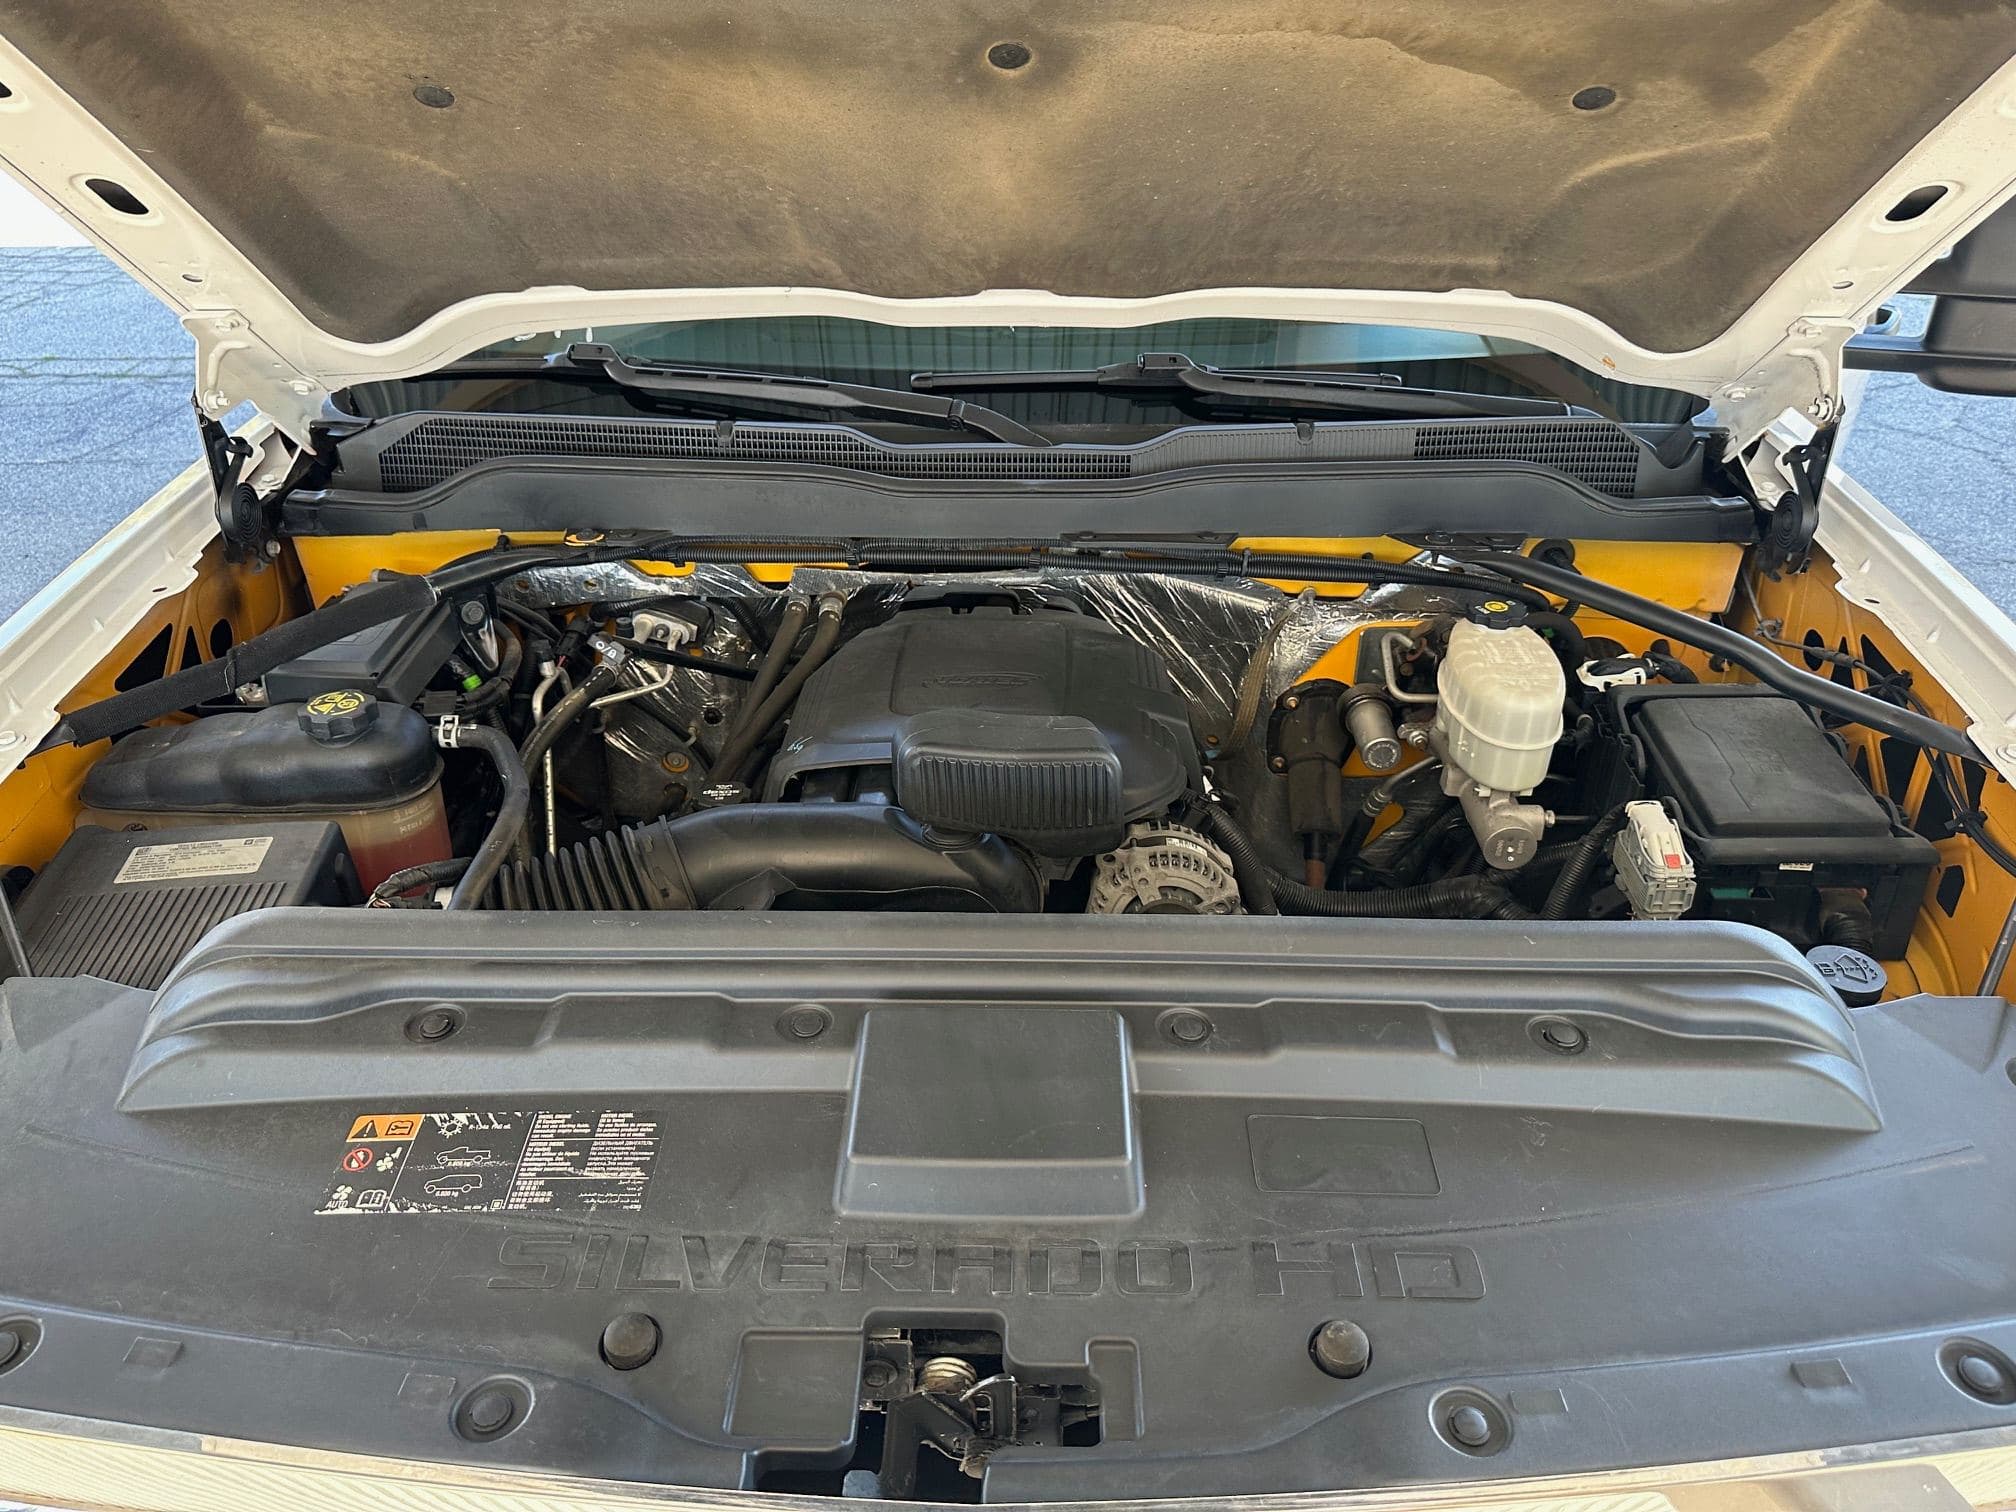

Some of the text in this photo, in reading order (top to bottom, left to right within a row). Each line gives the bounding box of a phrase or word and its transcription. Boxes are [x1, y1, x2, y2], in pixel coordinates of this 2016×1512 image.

[325, 1199, 349, 1209] AUTO
[487, 1233, 1487, 1300] SILVERADO HD
